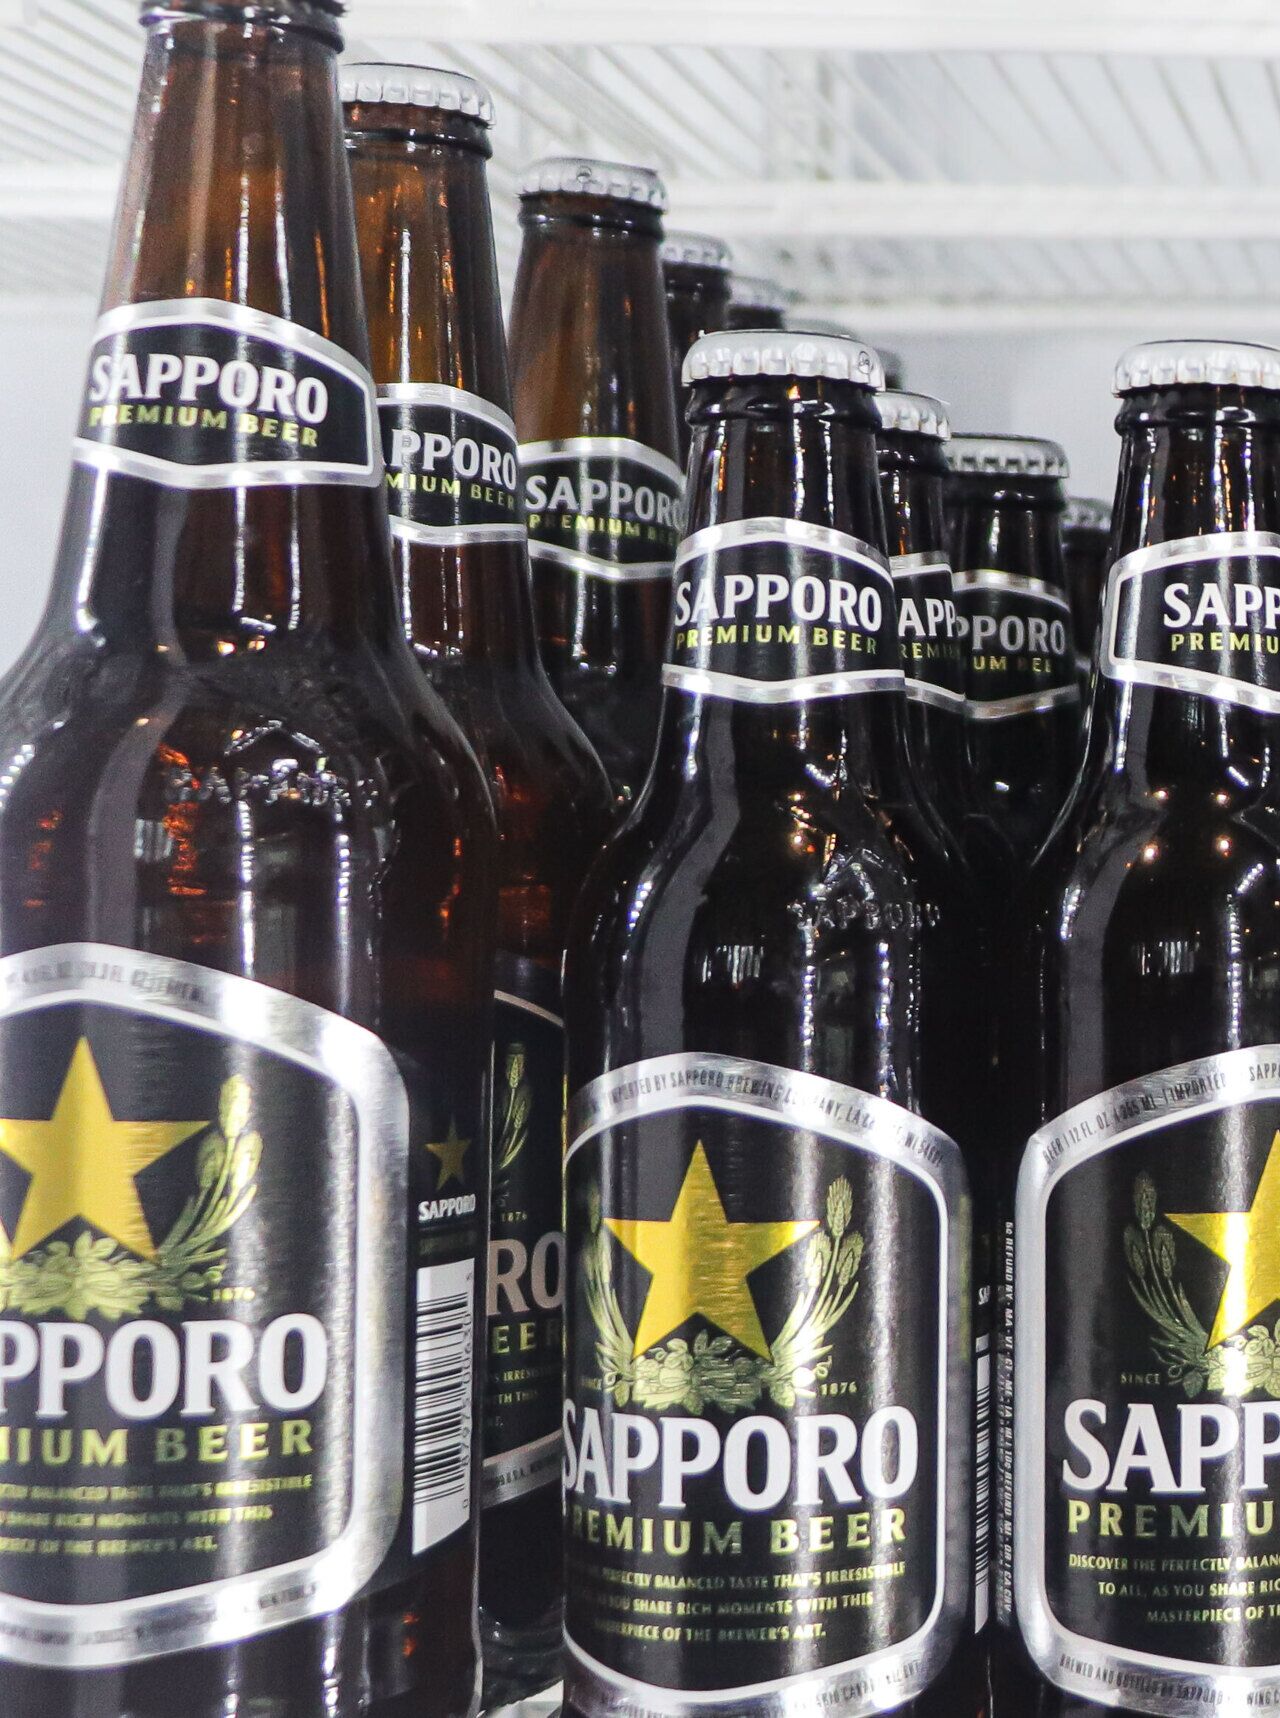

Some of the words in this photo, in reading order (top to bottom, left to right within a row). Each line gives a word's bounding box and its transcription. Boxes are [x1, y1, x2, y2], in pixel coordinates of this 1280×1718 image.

[88, 353, 329, 424] SAPPORO
[87, 403, 228, 430] PREMIUM
[237, 412, 319, 448] BEER
[386, 428, 517, 491] PPORO
[386, 473, 461, 498] MIUM
[470, 483, 516, 512] BEER
[674, 573, 883, 633] SAPPORO
[676, 624, 800, 651] PREMIUM
[812, 627, 878, 656] BEER
[956, 615, 1067, 656] PPORO
[0, 1312, 328, 1420] PPORO
[1120, 1371, 1160, 1386] SINCE
[820, 1381, 857, 1397] 1876
[155, 1420, 313, 1465] BEER
[563, 1397, 919, 1512] SAPPORO
[573, 1507, 743, 1557] REMIUM
[770, 1507, 907, 1555] BEER
[1069, 1553, 1128, 1571] DISCOVER
[633, 1599, 674, 1614] SHARE
[841, 1592, 874, 1608] THIS
[1098, 1580, 1115, 1596] TO
[1209, 1580, 1254, 1597] SHARE
[1245, 1604, 1264, 1620] OF
